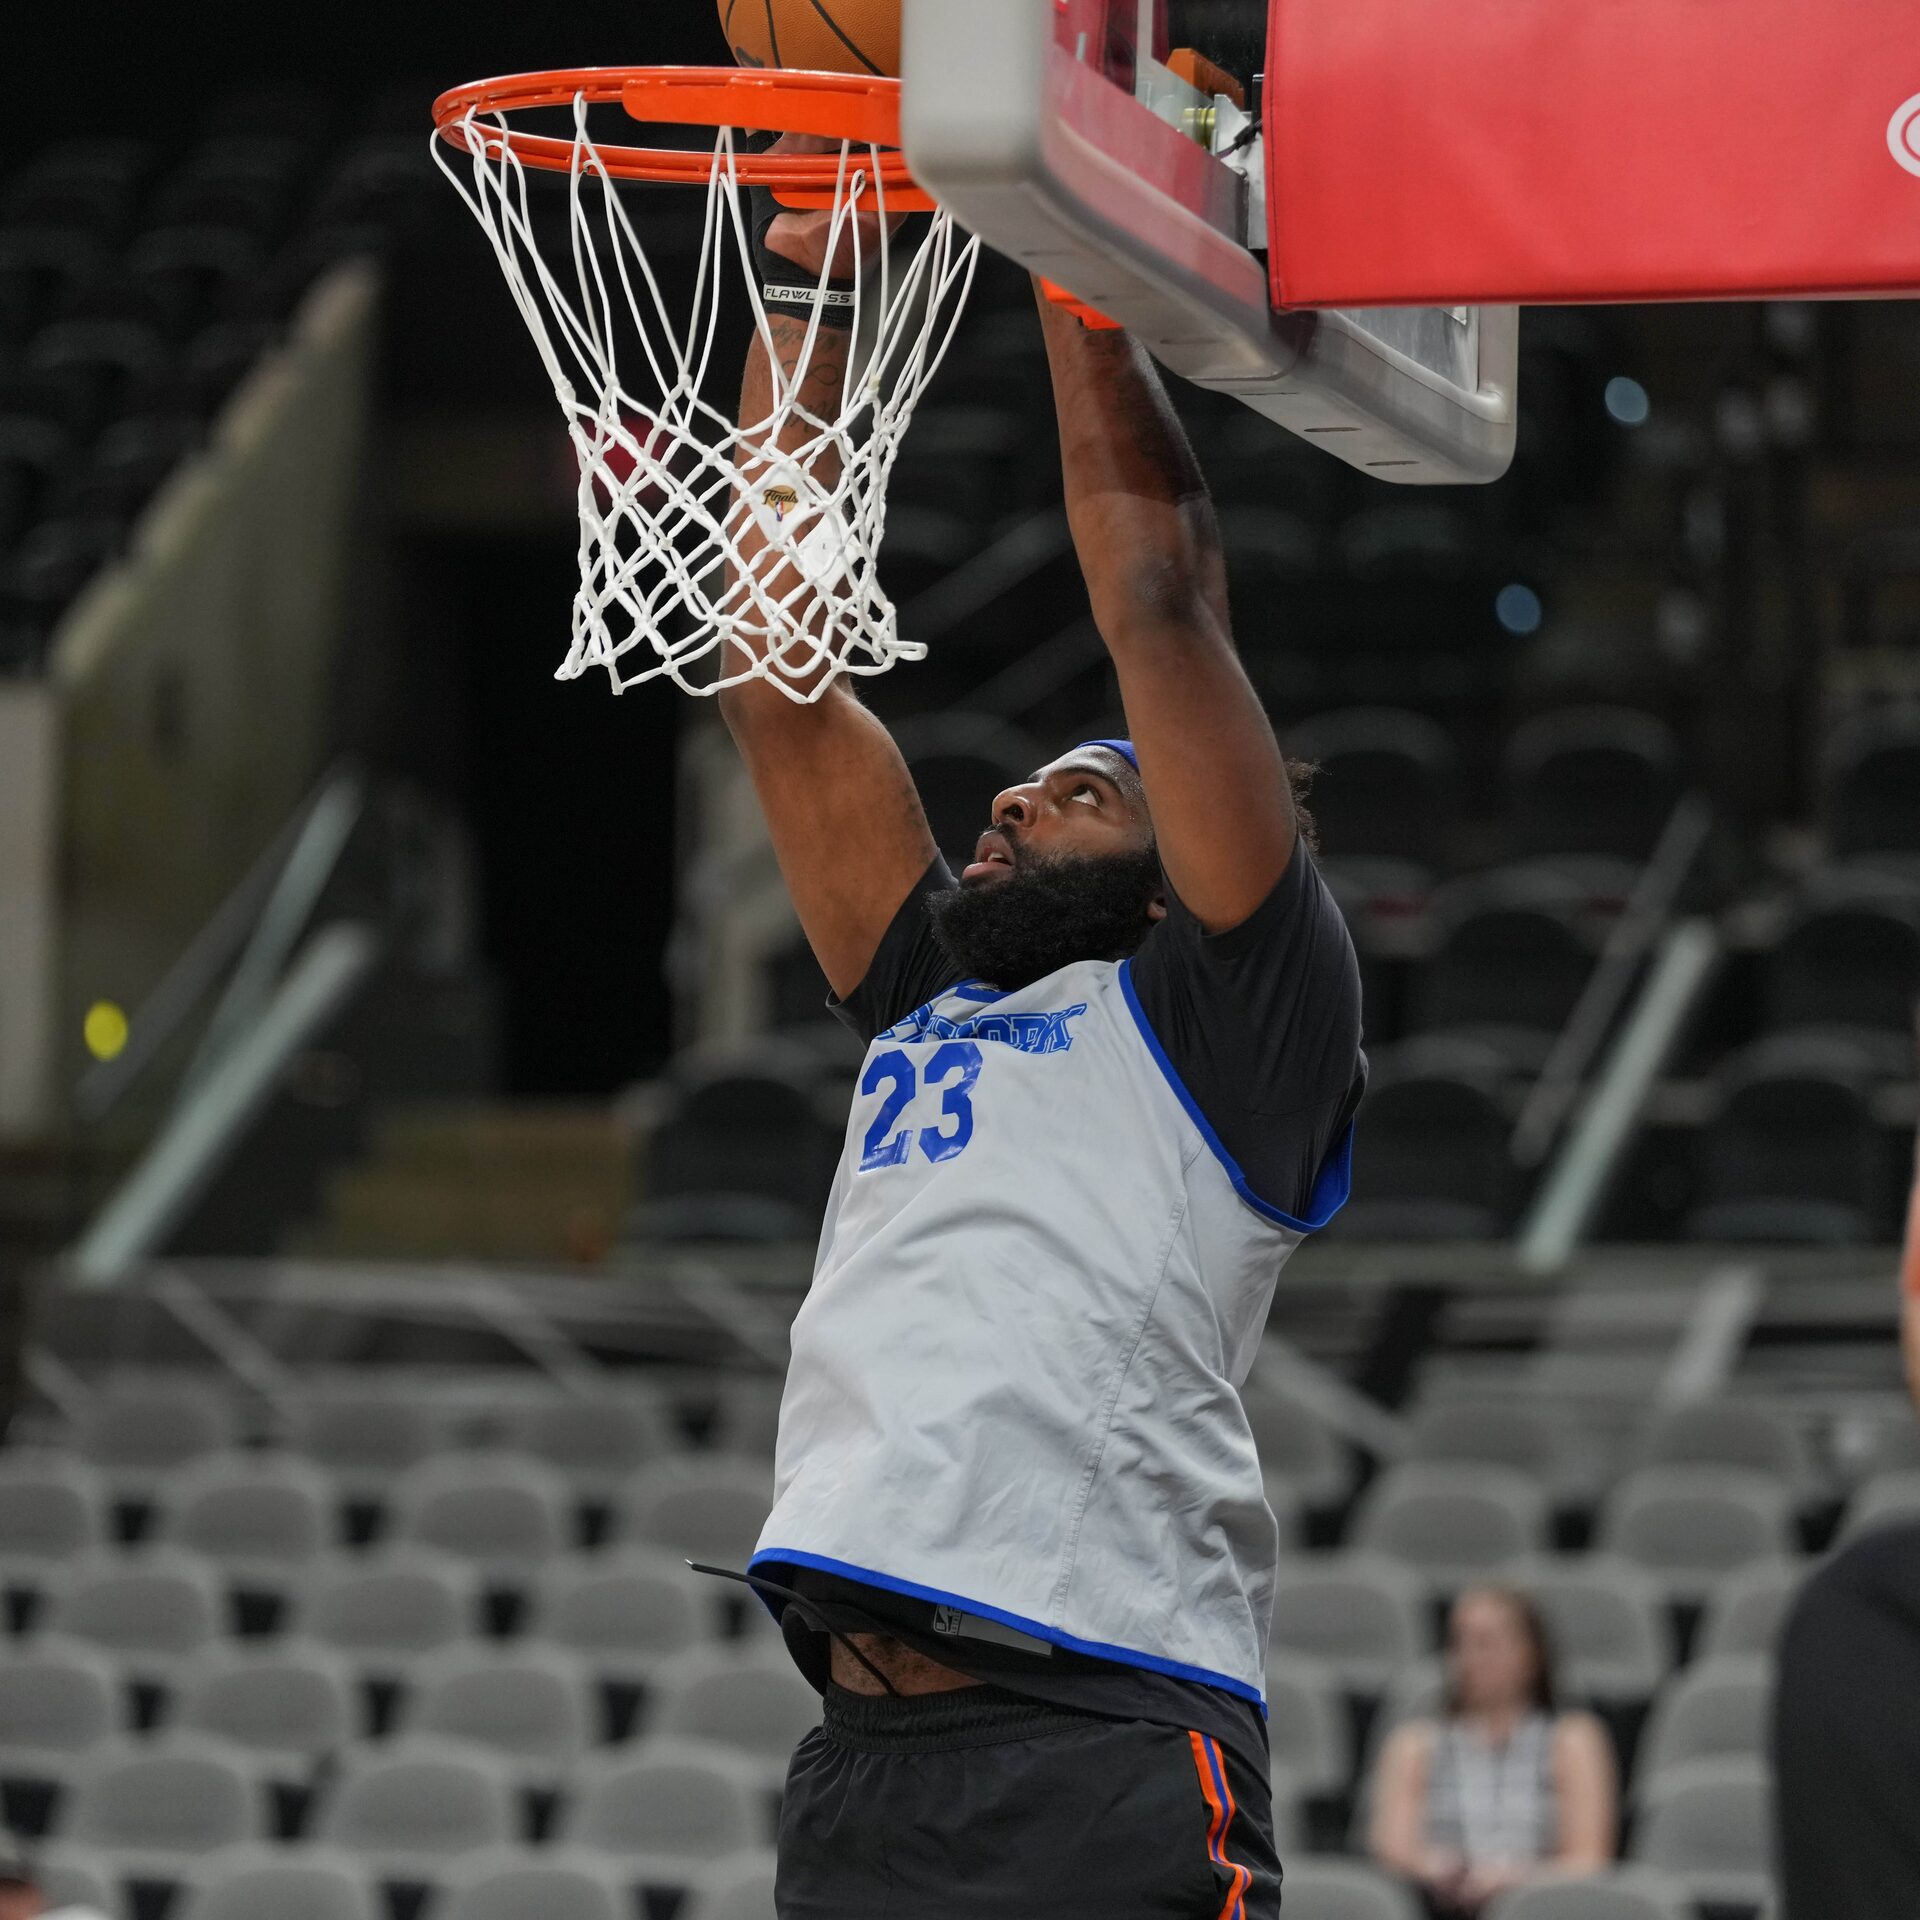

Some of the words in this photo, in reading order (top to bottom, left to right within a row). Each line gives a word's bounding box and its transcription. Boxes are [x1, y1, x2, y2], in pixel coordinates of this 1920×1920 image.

[765, 288, 851, 304] FLAWLSS
[762, 489, 799, 504] Finals
[857, 1041, 983, 1176] 23
